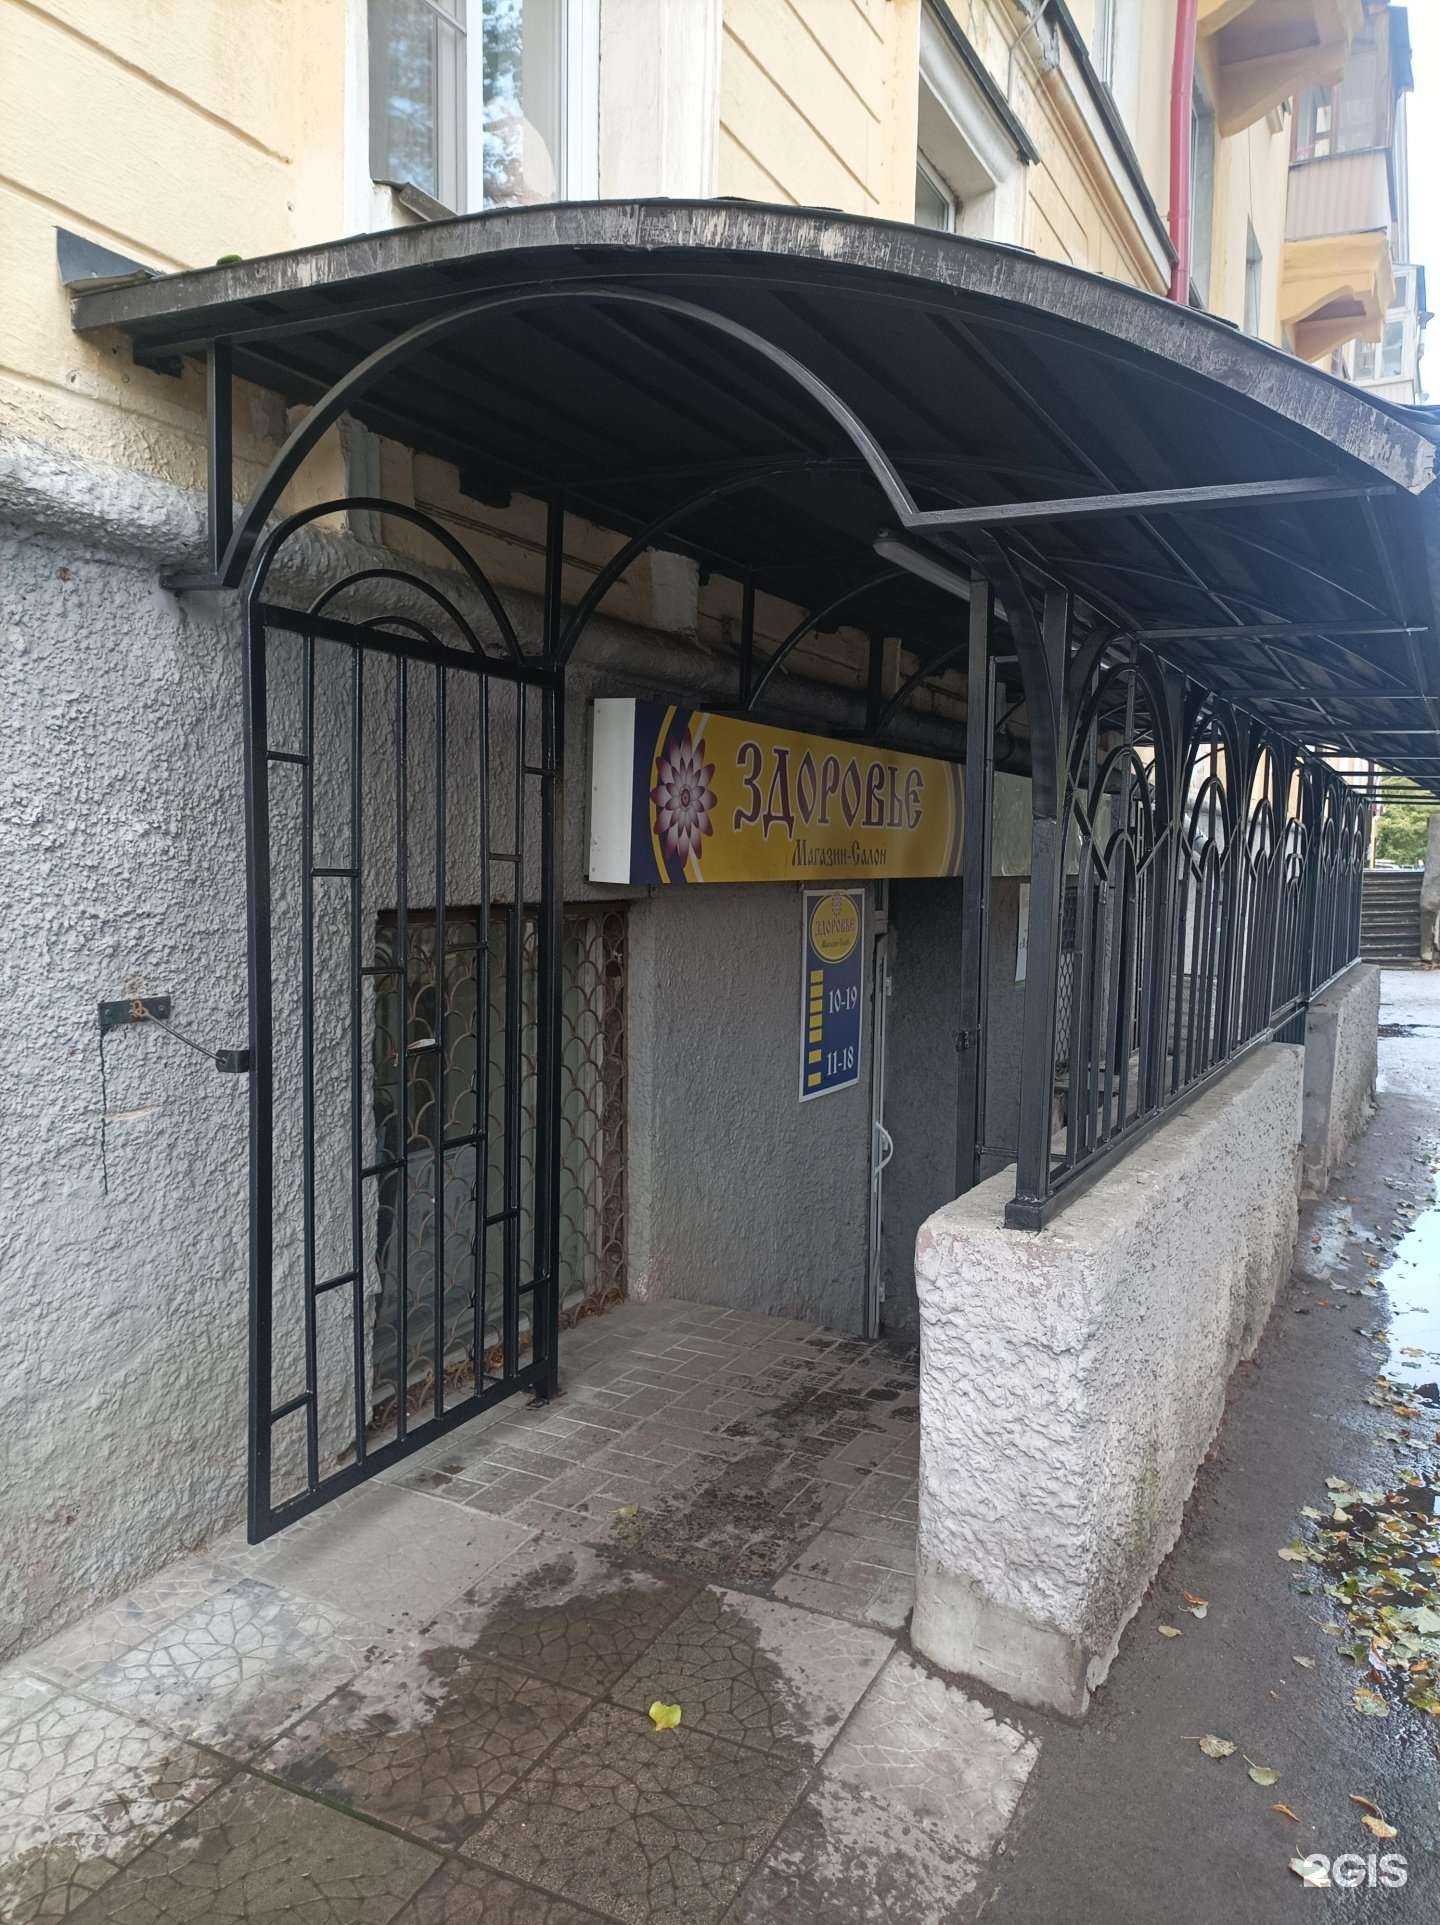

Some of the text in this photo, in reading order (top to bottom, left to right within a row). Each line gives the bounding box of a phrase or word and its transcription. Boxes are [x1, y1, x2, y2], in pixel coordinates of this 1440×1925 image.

[734, 741, 924, 839] ЗДОРОВЬЕ
[792, 839, 887, 867] Магазин-Салон
[829, 985, 858, 1014] 10-19
[827, 1046, 854, 1076] 11-18
